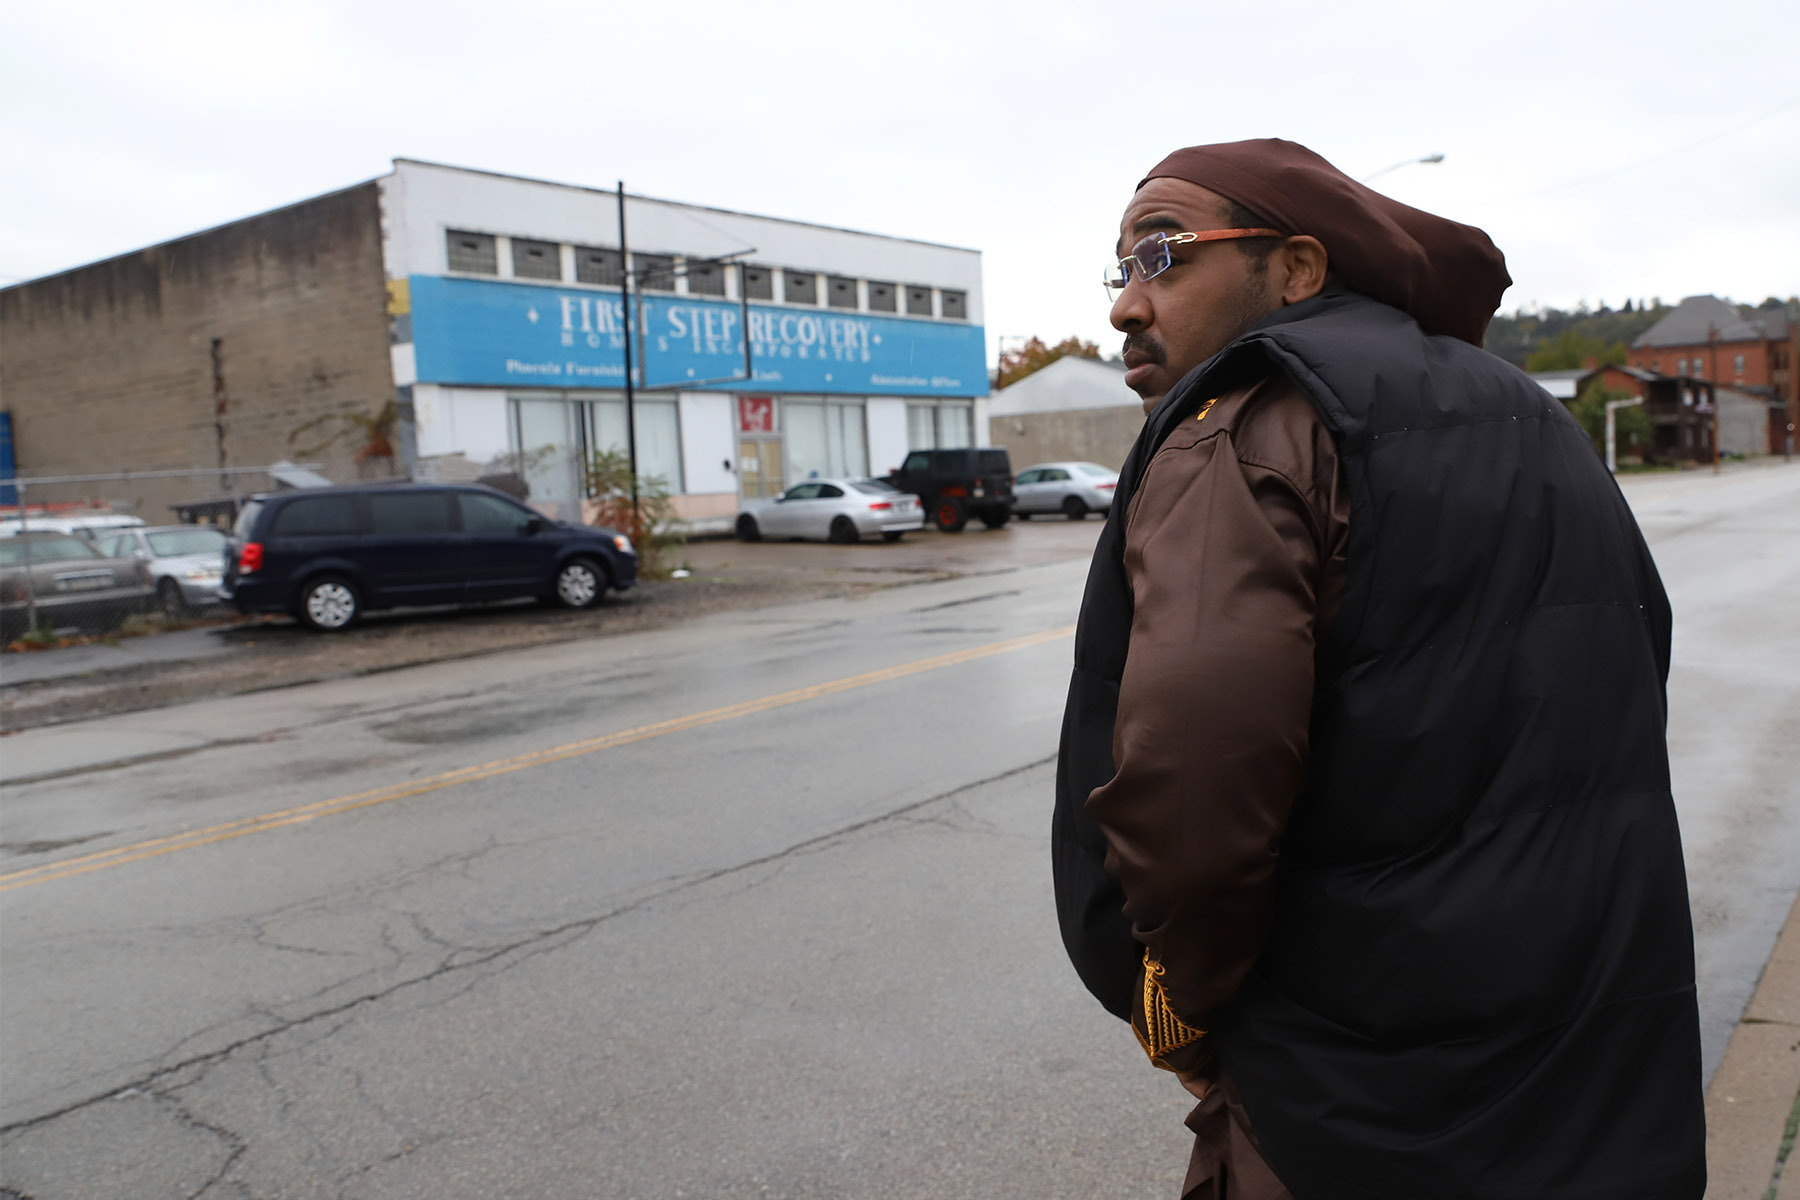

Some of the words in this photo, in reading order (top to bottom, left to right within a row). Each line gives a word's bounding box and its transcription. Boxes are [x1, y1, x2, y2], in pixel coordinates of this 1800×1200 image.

[559, 295, 653, 336] FIRST
[667, 305, 737, 341] STEP
[747, 310, 871, 350] RECOVERY
